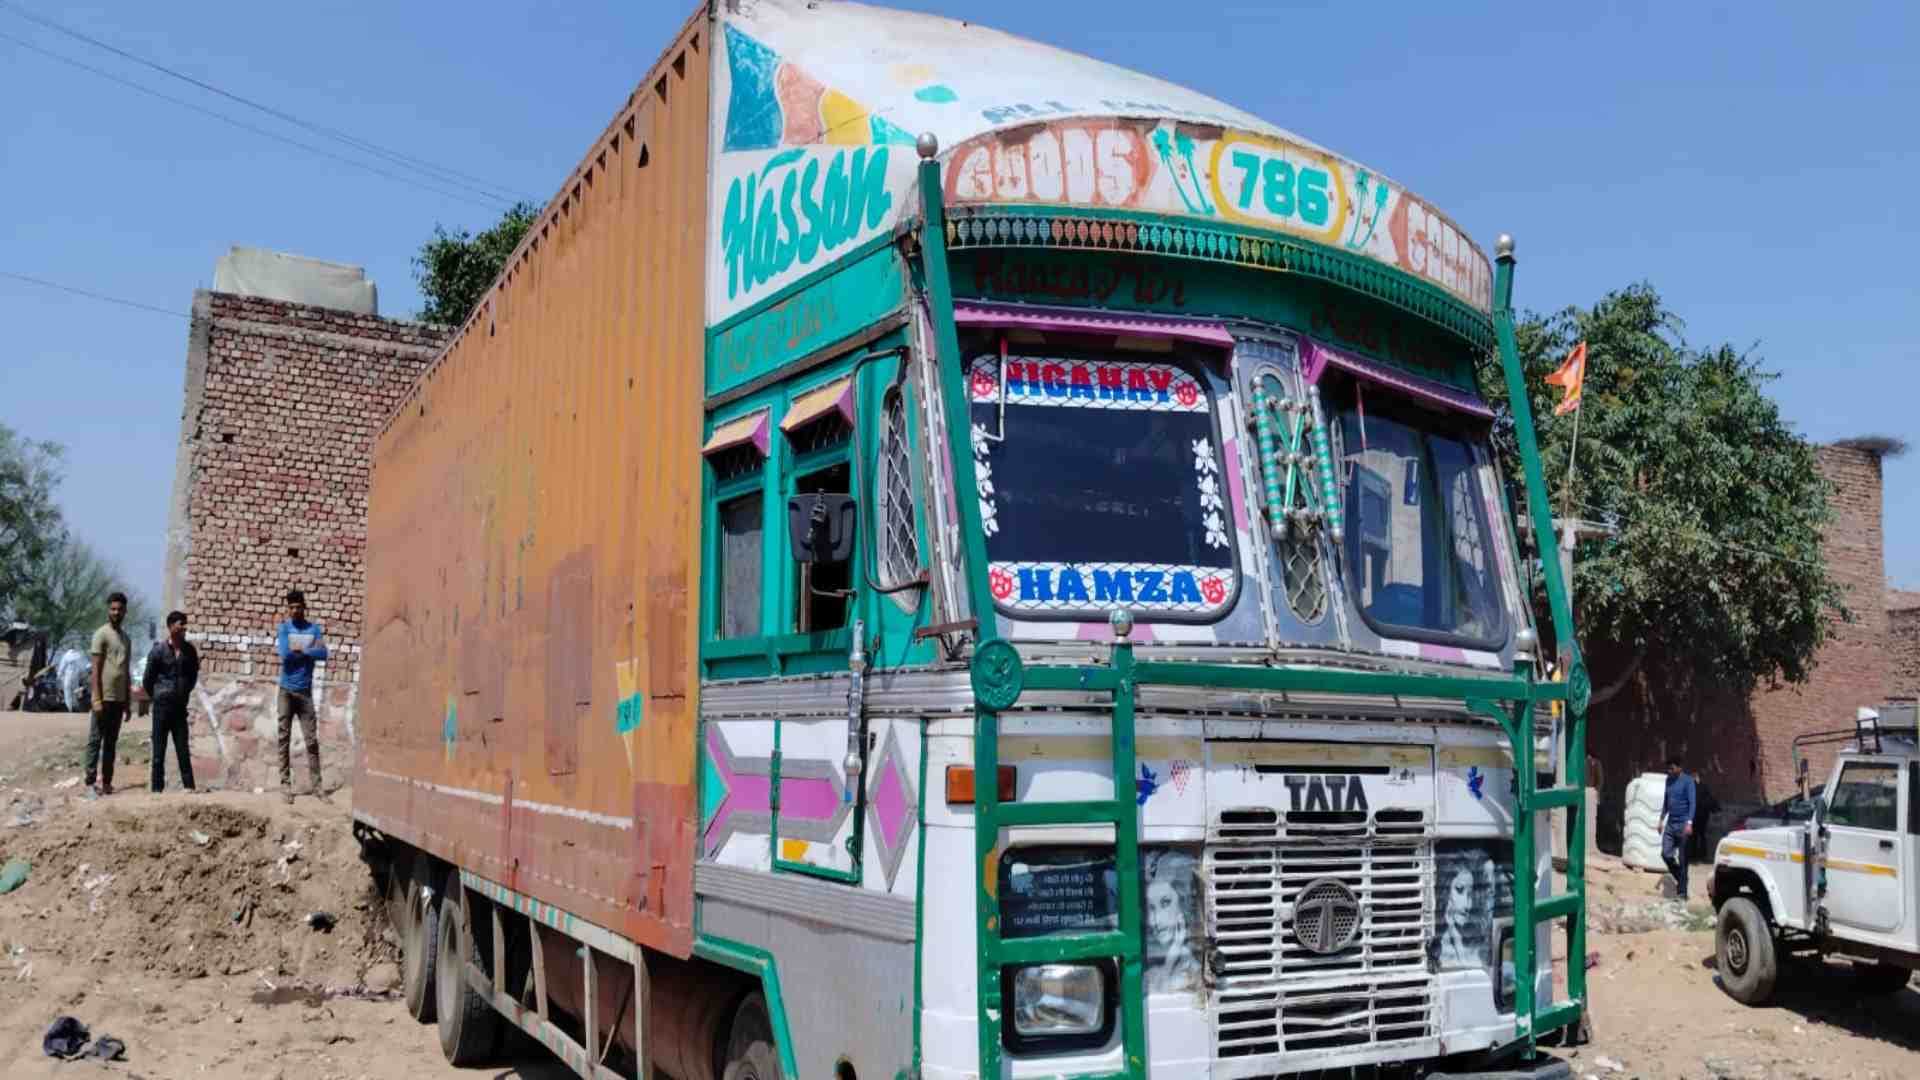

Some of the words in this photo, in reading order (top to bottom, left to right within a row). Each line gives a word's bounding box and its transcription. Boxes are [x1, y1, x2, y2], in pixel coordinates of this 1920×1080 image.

[955, 128, 1134, 205] GOODS
[1232, 150, 1330, 227] 786
[1006, 362, 1174, 402] NIGAHAY
[1017, 567, 1202, 603] HAMZA
[1283, 774, 1369, 812] TATA
